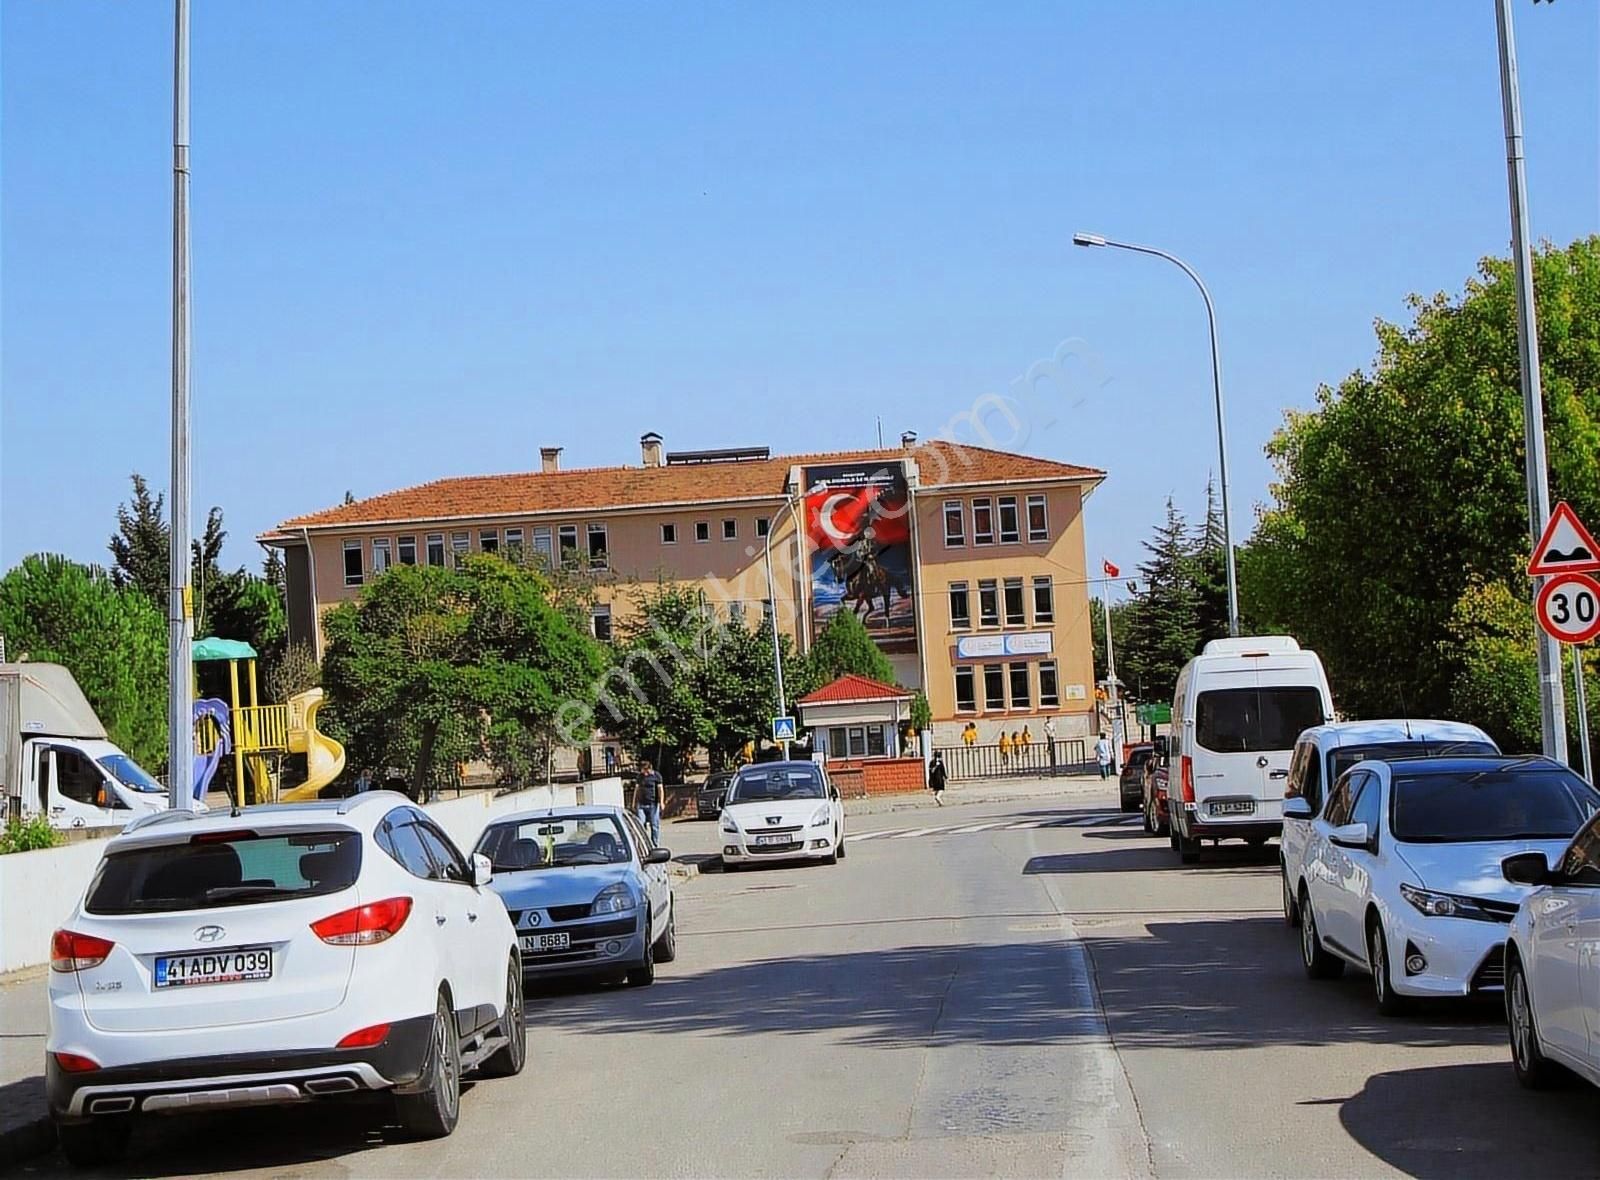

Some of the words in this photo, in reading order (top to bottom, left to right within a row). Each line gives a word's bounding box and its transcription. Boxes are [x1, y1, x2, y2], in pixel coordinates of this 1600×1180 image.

[1551, 591, 1595, 624] 30
[540, 933, 569, 948] 8683
[234, 951, 269, 973] 039
